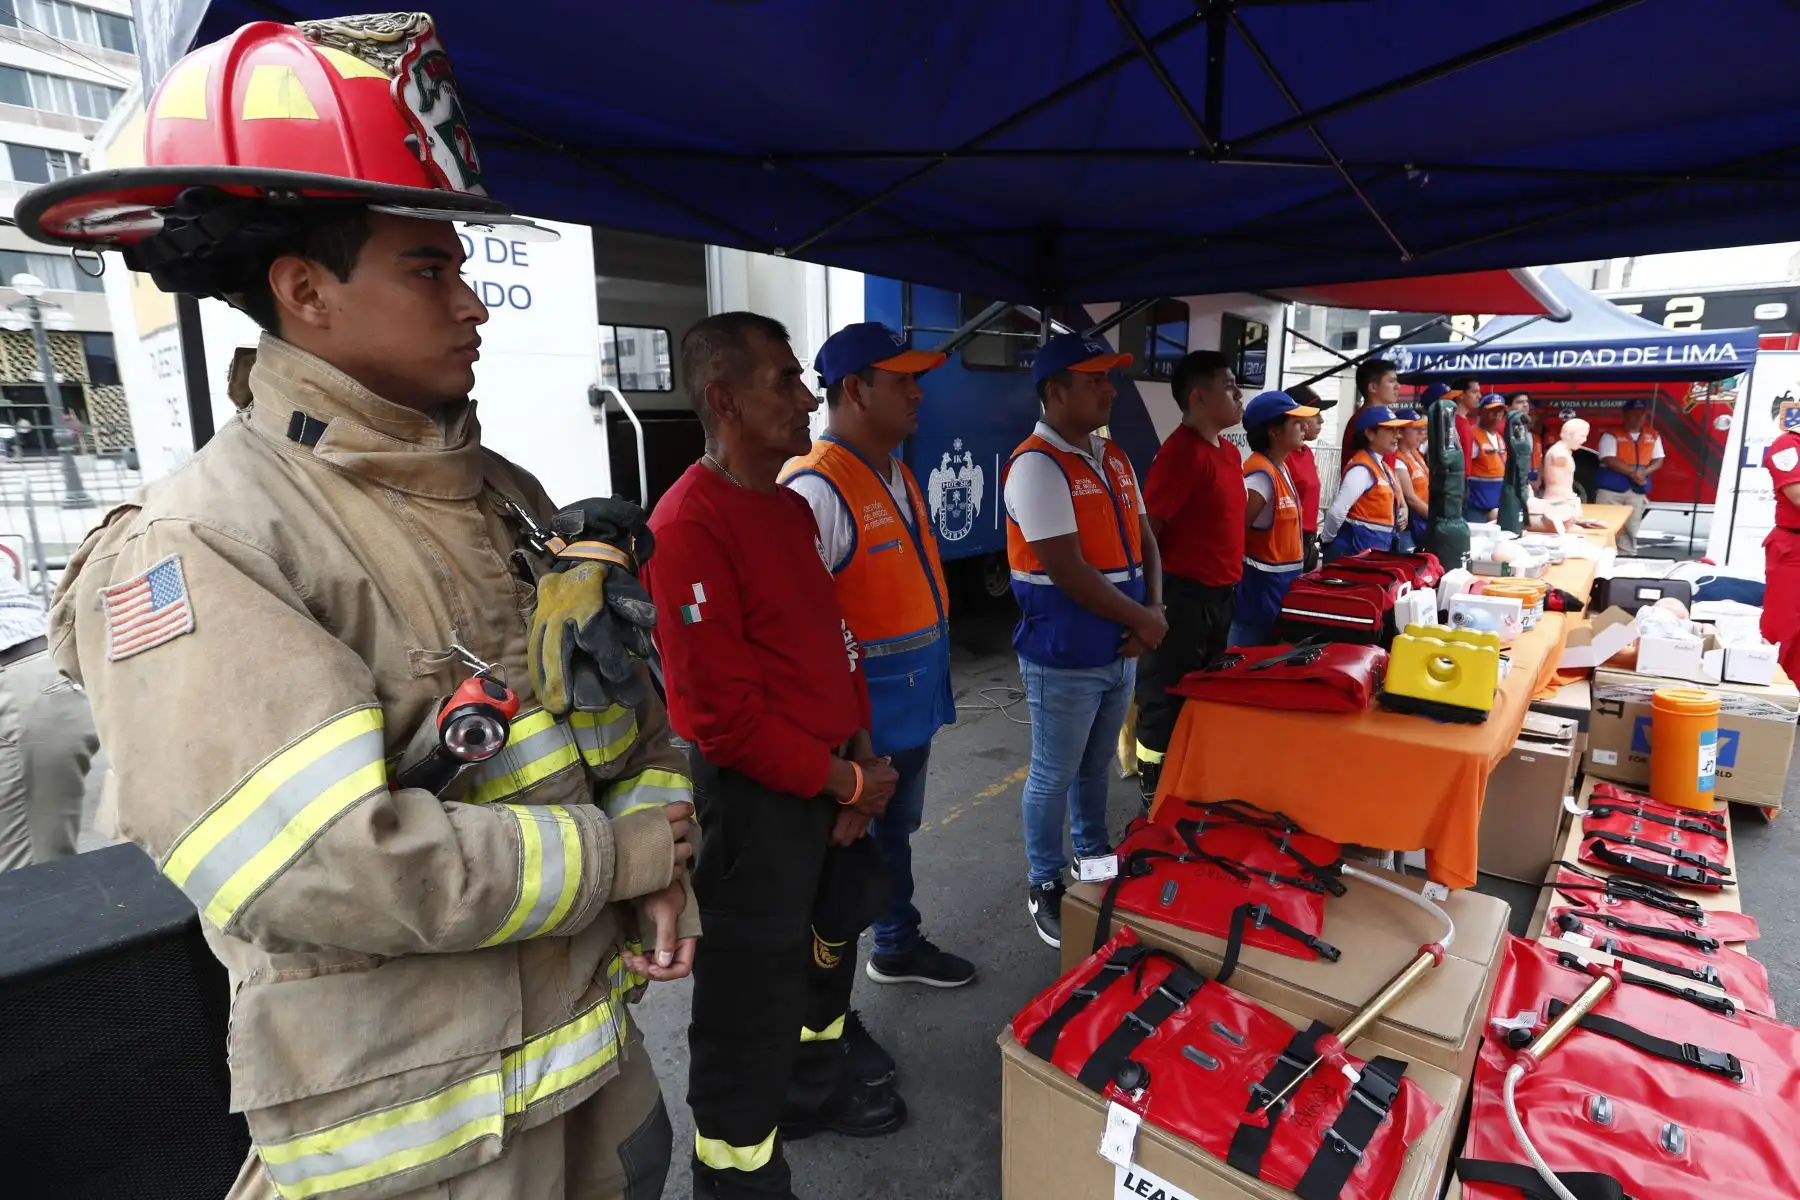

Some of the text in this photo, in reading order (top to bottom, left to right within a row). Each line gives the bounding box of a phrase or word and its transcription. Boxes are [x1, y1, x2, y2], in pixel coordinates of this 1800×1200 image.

[484, 236, 529, 267] DE
[473, 280, 532, 310] DO
[1663, 296, 1706, 332] 2
[1424, 342, 1738, 371] MUNICIPALIDAD DE LIMA
[1123, 1171, 1179, 1200] LEA
